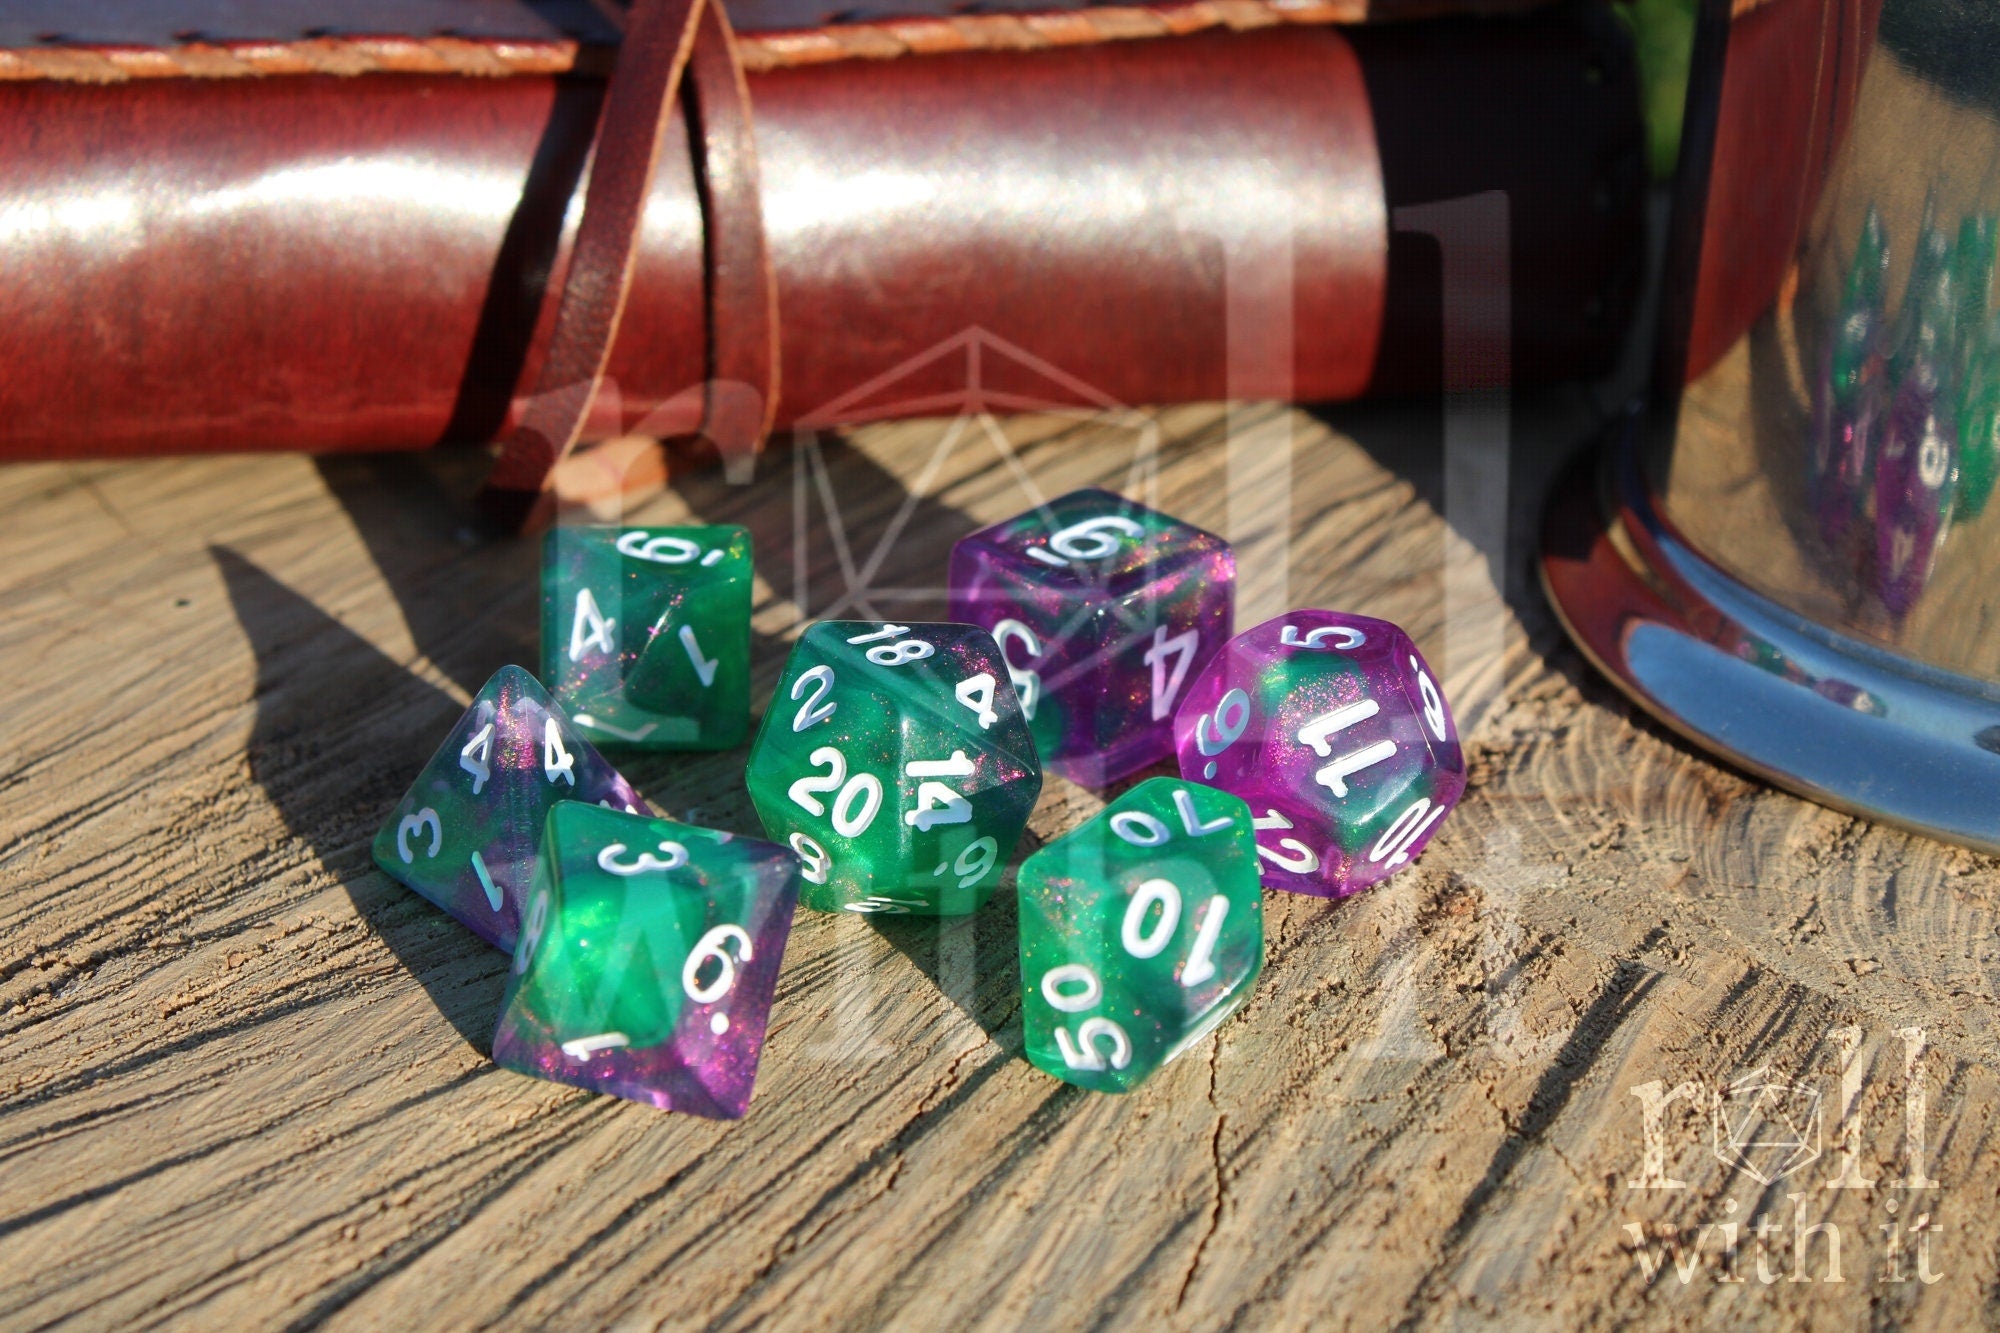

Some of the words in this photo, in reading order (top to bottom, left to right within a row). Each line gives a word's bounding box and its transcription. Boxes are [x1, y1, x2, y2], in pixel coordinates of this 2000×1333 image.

[569, 588, 616, 662] 4
[679, 625, 719, 687] 1
[847, 624, 935, 666] 18
[1281, 625, 1367, 650] 5
[790, 665, 838, 732] 2
[955, 672, 998, 730] 4
[992, 619, 1042, 720] 5
[1144, 624, 1199, 721] 4
[460, 723, 496, 795] 4
[544, 717, 575, 787] 4
[1298, 699, 1398, 798] 11
[788, 747, 883, 838] 20
[904, 750, 976, 832] 14
[1110, 789, 1234, 848] 70
[397, 807, 442, 864] 3
[598, 841, 689, 876] 3
[472, 850, 503, 912] 1
[1121, 878, 1230, 988] 10
[561, 1031, 630, 1061] 1
[1041, 963, 1132, 1072] 50
